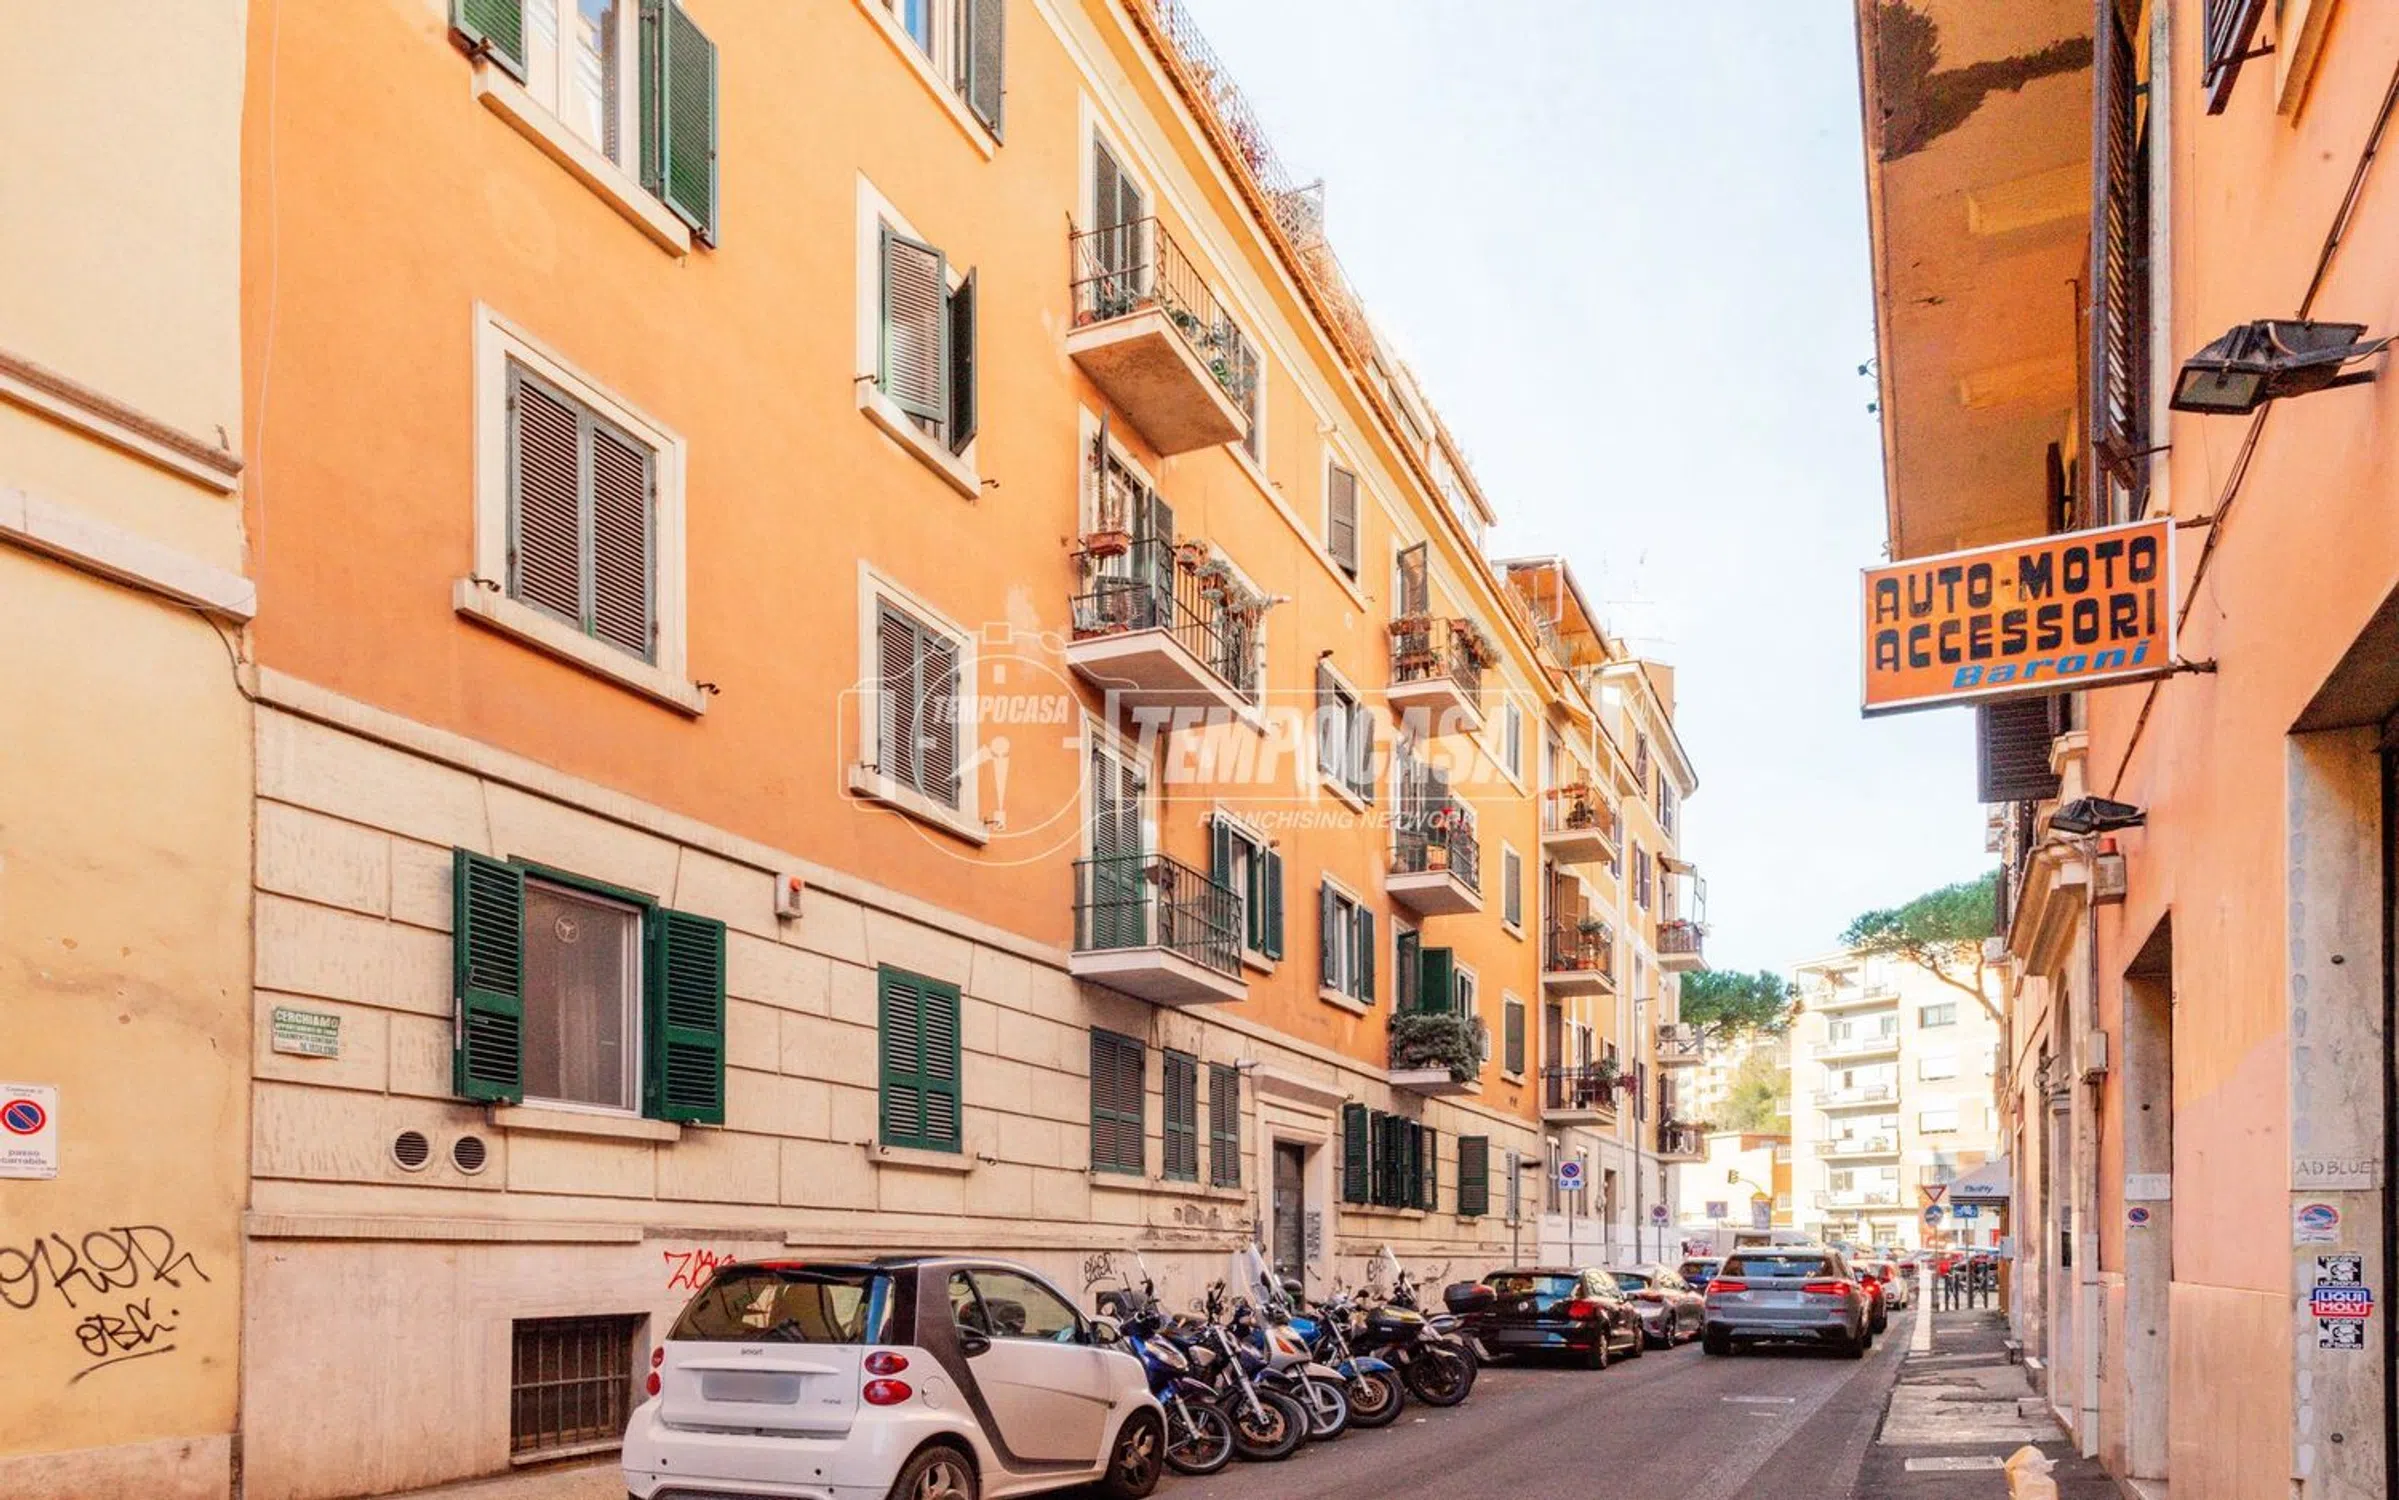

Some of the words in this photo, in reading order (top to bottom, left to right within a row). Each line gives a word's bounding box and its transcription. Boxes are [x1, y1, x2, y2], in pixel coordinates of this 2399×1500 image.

[1875, 536, 2157, 624] AUTO-MOTO
[1875, 588, 2156, 672] ACCESSORI
[1953, 640, 2150, 689] Baroni
[276, 1010, 337, 1029] CERCHIAMO
[2320, 1291, 2362, 1302] LIQUI
[2320, 1302, 2362, 1312] MOLY
